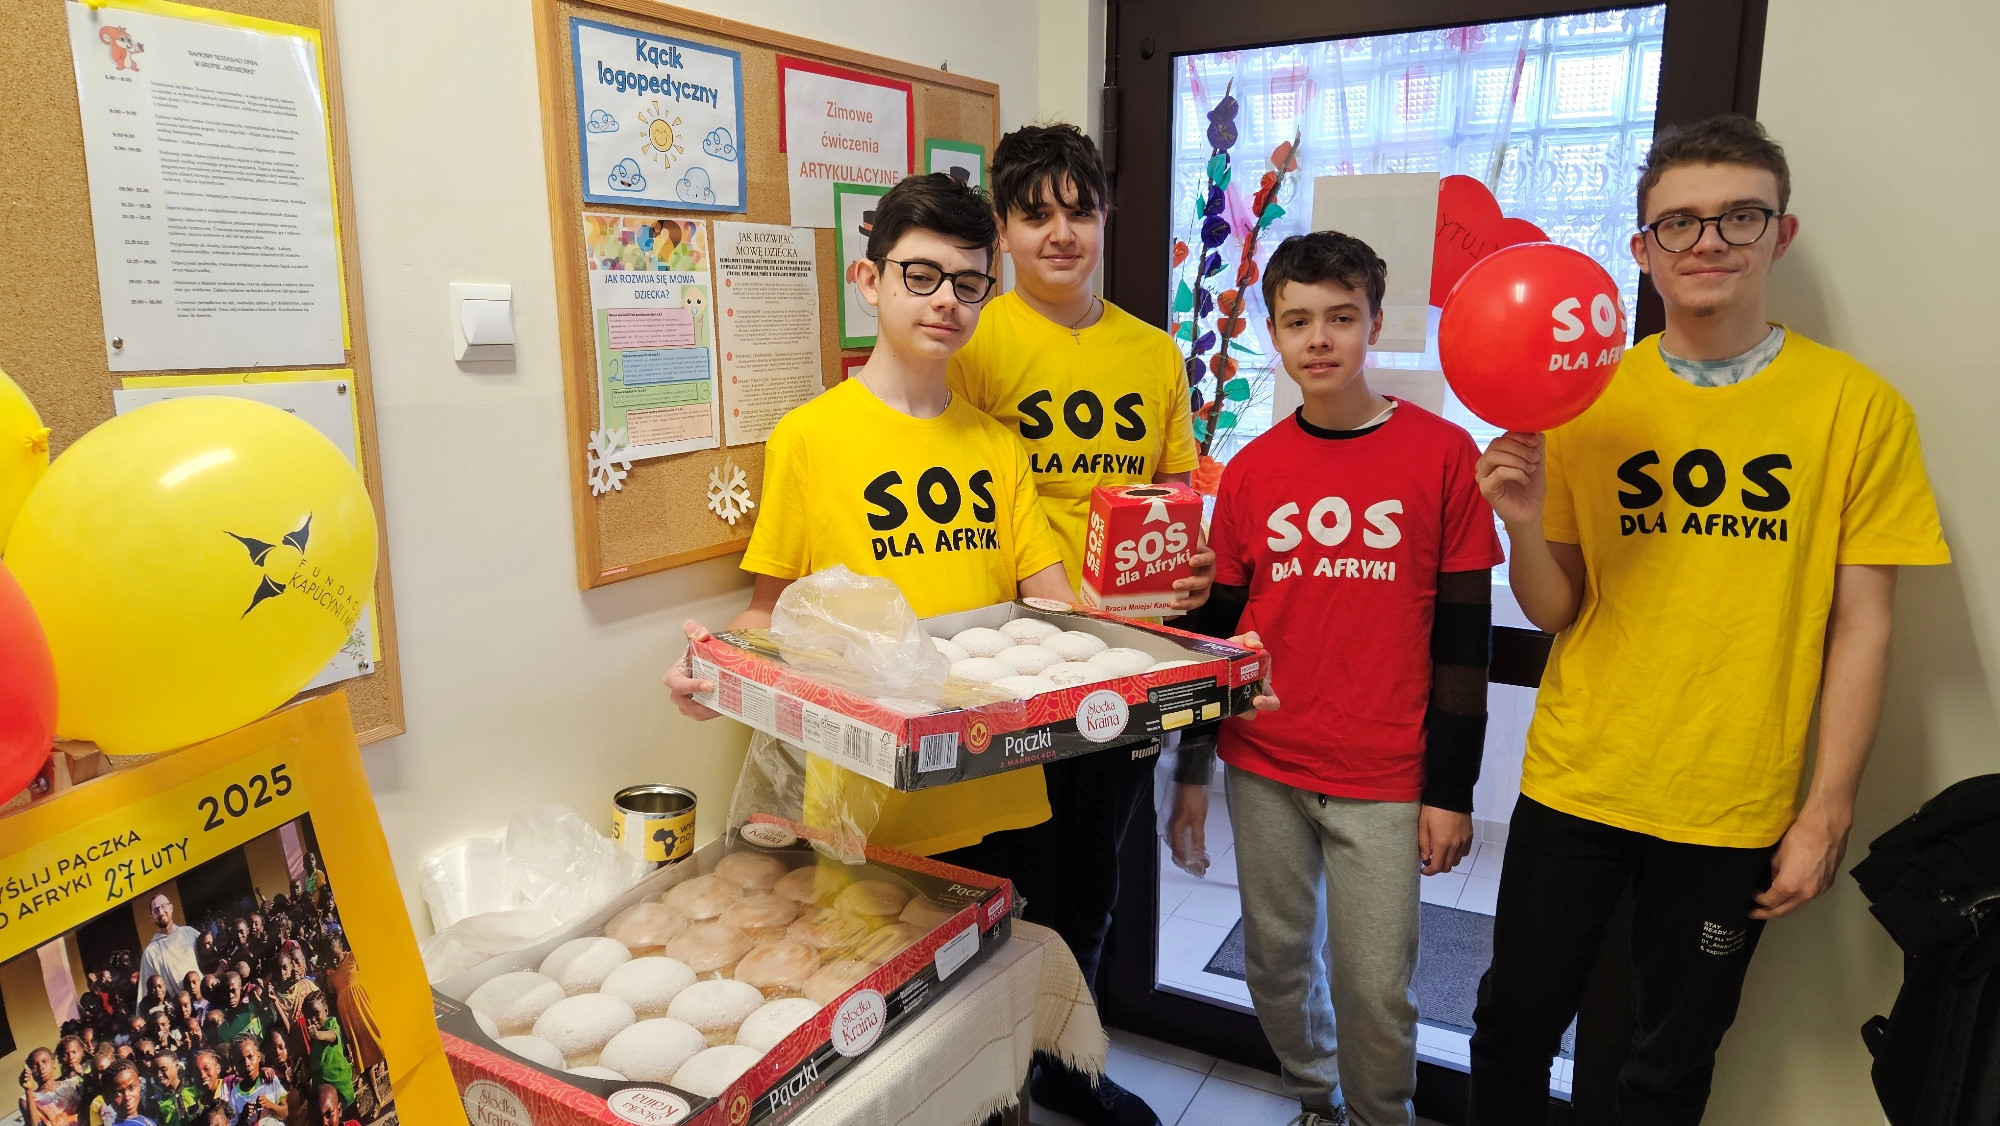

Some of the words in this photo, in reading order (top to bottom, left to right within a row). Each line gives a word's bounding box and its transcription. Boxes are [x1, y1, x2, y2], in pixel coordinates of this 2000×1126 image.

[635, 37, 684, 71] Kącik
[597, 60, 719, 110] logopedyczny
[826, 100, 873, 125] Zimowe
[820, 131, 880, 155] ćwiczenia
[799, 161, 899, 186] ARTYKULACYJNE
[736, 245, 763, 259] MOWĘ
[764, 247, 798, 258] DZIECKA
[737, 232, 752, 244] JAK
[754, 232, 794, 247] ROZWIJAĆ
[605, 274, 618, 284] JAK
[621, 274, 654, 284] ROZWIJA
[656, 274, 667, 285] SIĘ
[669, 274, 695, 284] MOWA
[635, 289, 670, 299] DZIECKA?
[1549, 351, 1589, 371] DLA
[1017, 389, 1147, 442] SOS
[1028, 453, 1063, 474] LA
[1072, 453, 1145, 476] AFRYKI
[1617, 448, 1793, 512] SOS
[863, 466, 996, 531] SOS
[1267, 496, 1404, 552] SOS
[1620, 511, 1667, 536] DLA
[1681, 512, 1788, 542] AFRYKI
[872, 532, 925, 561] DLA
[1086, 511, 1100, 572] SOS
[1114, 521, 1188, 572] SOS
[1116, 570, 1140, 587] dla
[1144, 549, 1191, 578] Afryki
[1271, 557, 1302, 582] DLA
[1313, 557, 1396, 582] AFRYKI
[288, 572, 344, 618] KAPUCYNI
[299, 558, 361, 620] FUNDAC
[1105, 604, 1127, 613] Bracia
[1128, 602, 1153, 612] Mniejsi
[1154, 601, 1171, 610] Kapu
[1085, 712, 1120, 732] Kraina
[1087, 701, 1116, 716] Słodka
[1005, 727, 1052, 757] Pączki
[1131, 743, 1159, 760] PUMA
[197, 763, 293, 832] 2025
[0, 867, 51, 904] ŚLIJ
[58, 830, 142, 876] PĄCZKA
[104, 859, 136, 902] 27
[141, 838, 189, 877] LUTY
[18, 872, 93, 921] AFRYKI
[1703, 926, 1728, 936] READY
[1704, 921, 1721, 929] STAY
[842, 999, 872, 1028] Słodka
[842, 1012, 878, 1046] Kraina
[769, 1058, 819, 1114] Pączki
[479, 1089, 517, 1117] Słodka
[622, 1102, 662, 1122] Słodka
[632, 1093, 679, 1118] Kraina
